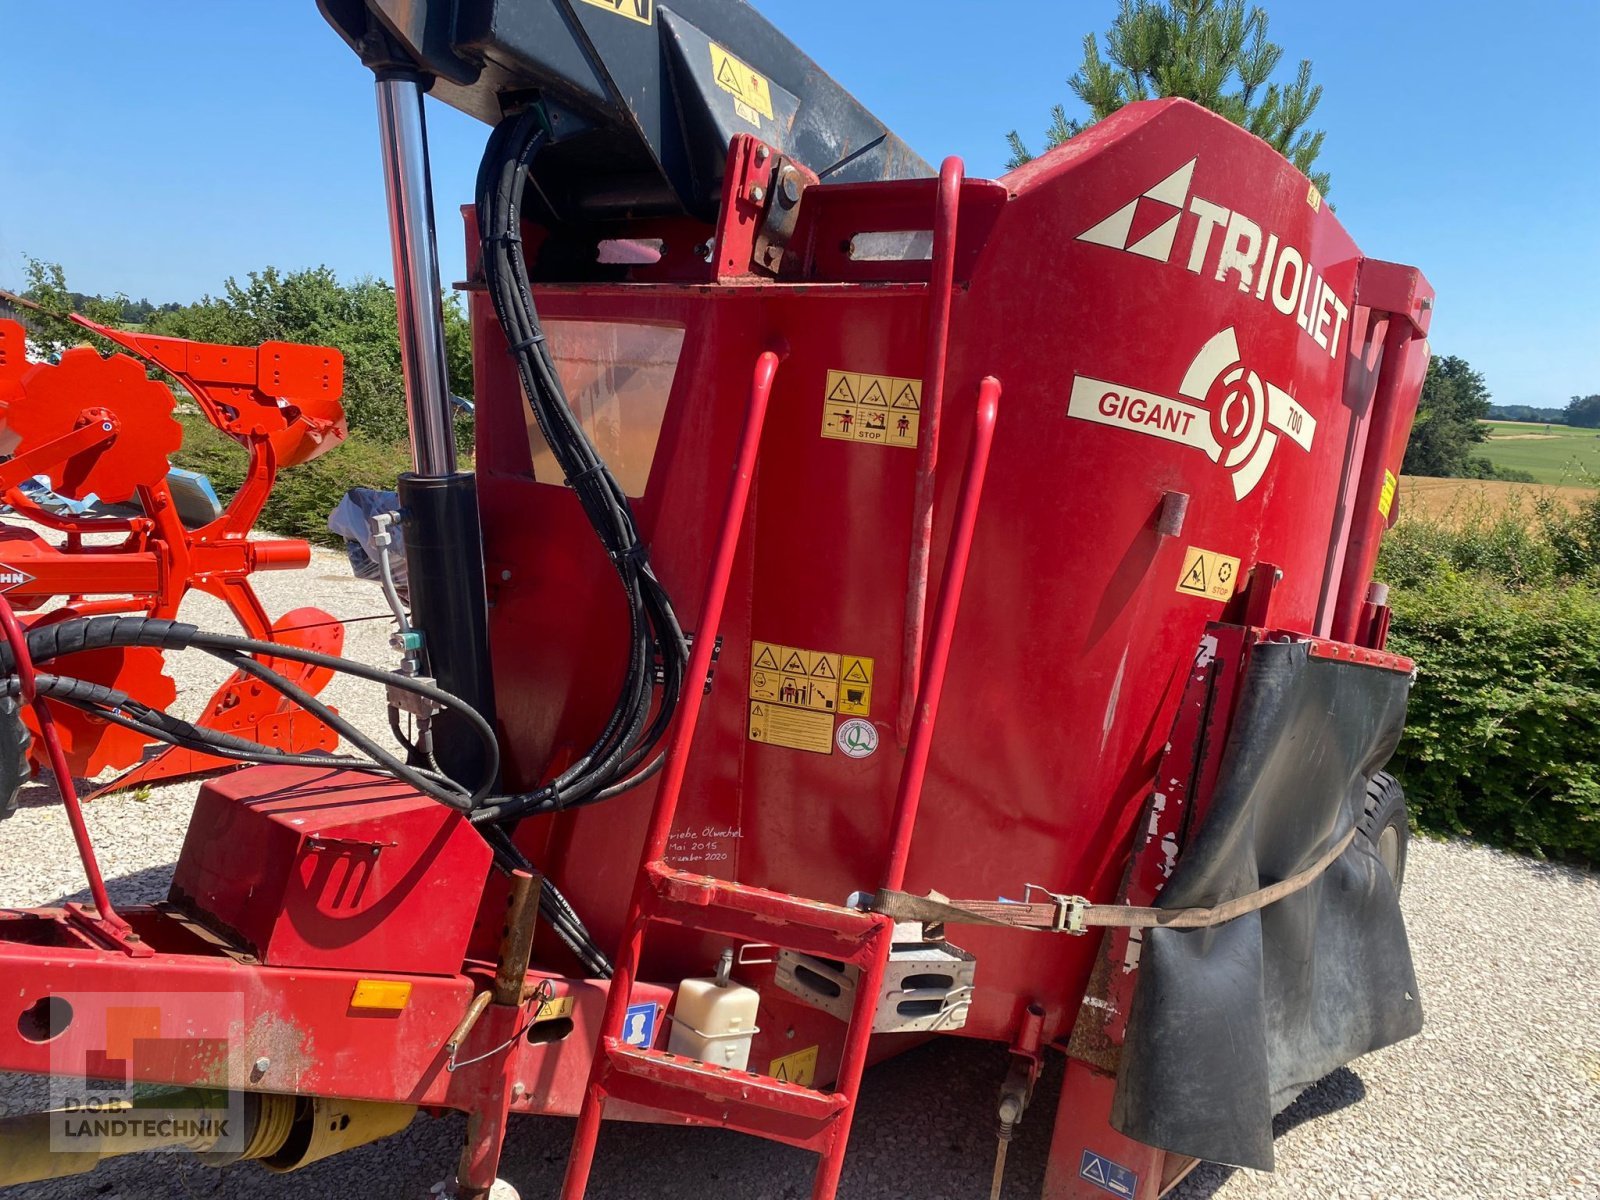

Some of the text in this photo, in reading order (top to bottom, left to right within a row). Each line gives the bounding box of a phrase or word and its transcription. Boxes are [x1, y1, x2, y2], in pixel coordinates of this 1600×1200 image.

[1187, 196, 1349, 359] TRIOLIET
[1099, 392, 1303, 436] GIGANT 700
[859, 431, 881, 439] STOP
[0, 573, 24, 583] HN
[1212, 586, 1229, 596] STOP
[669, 841, 717, 851] Mai 2015
[704, 852, 728, 861] 2020
